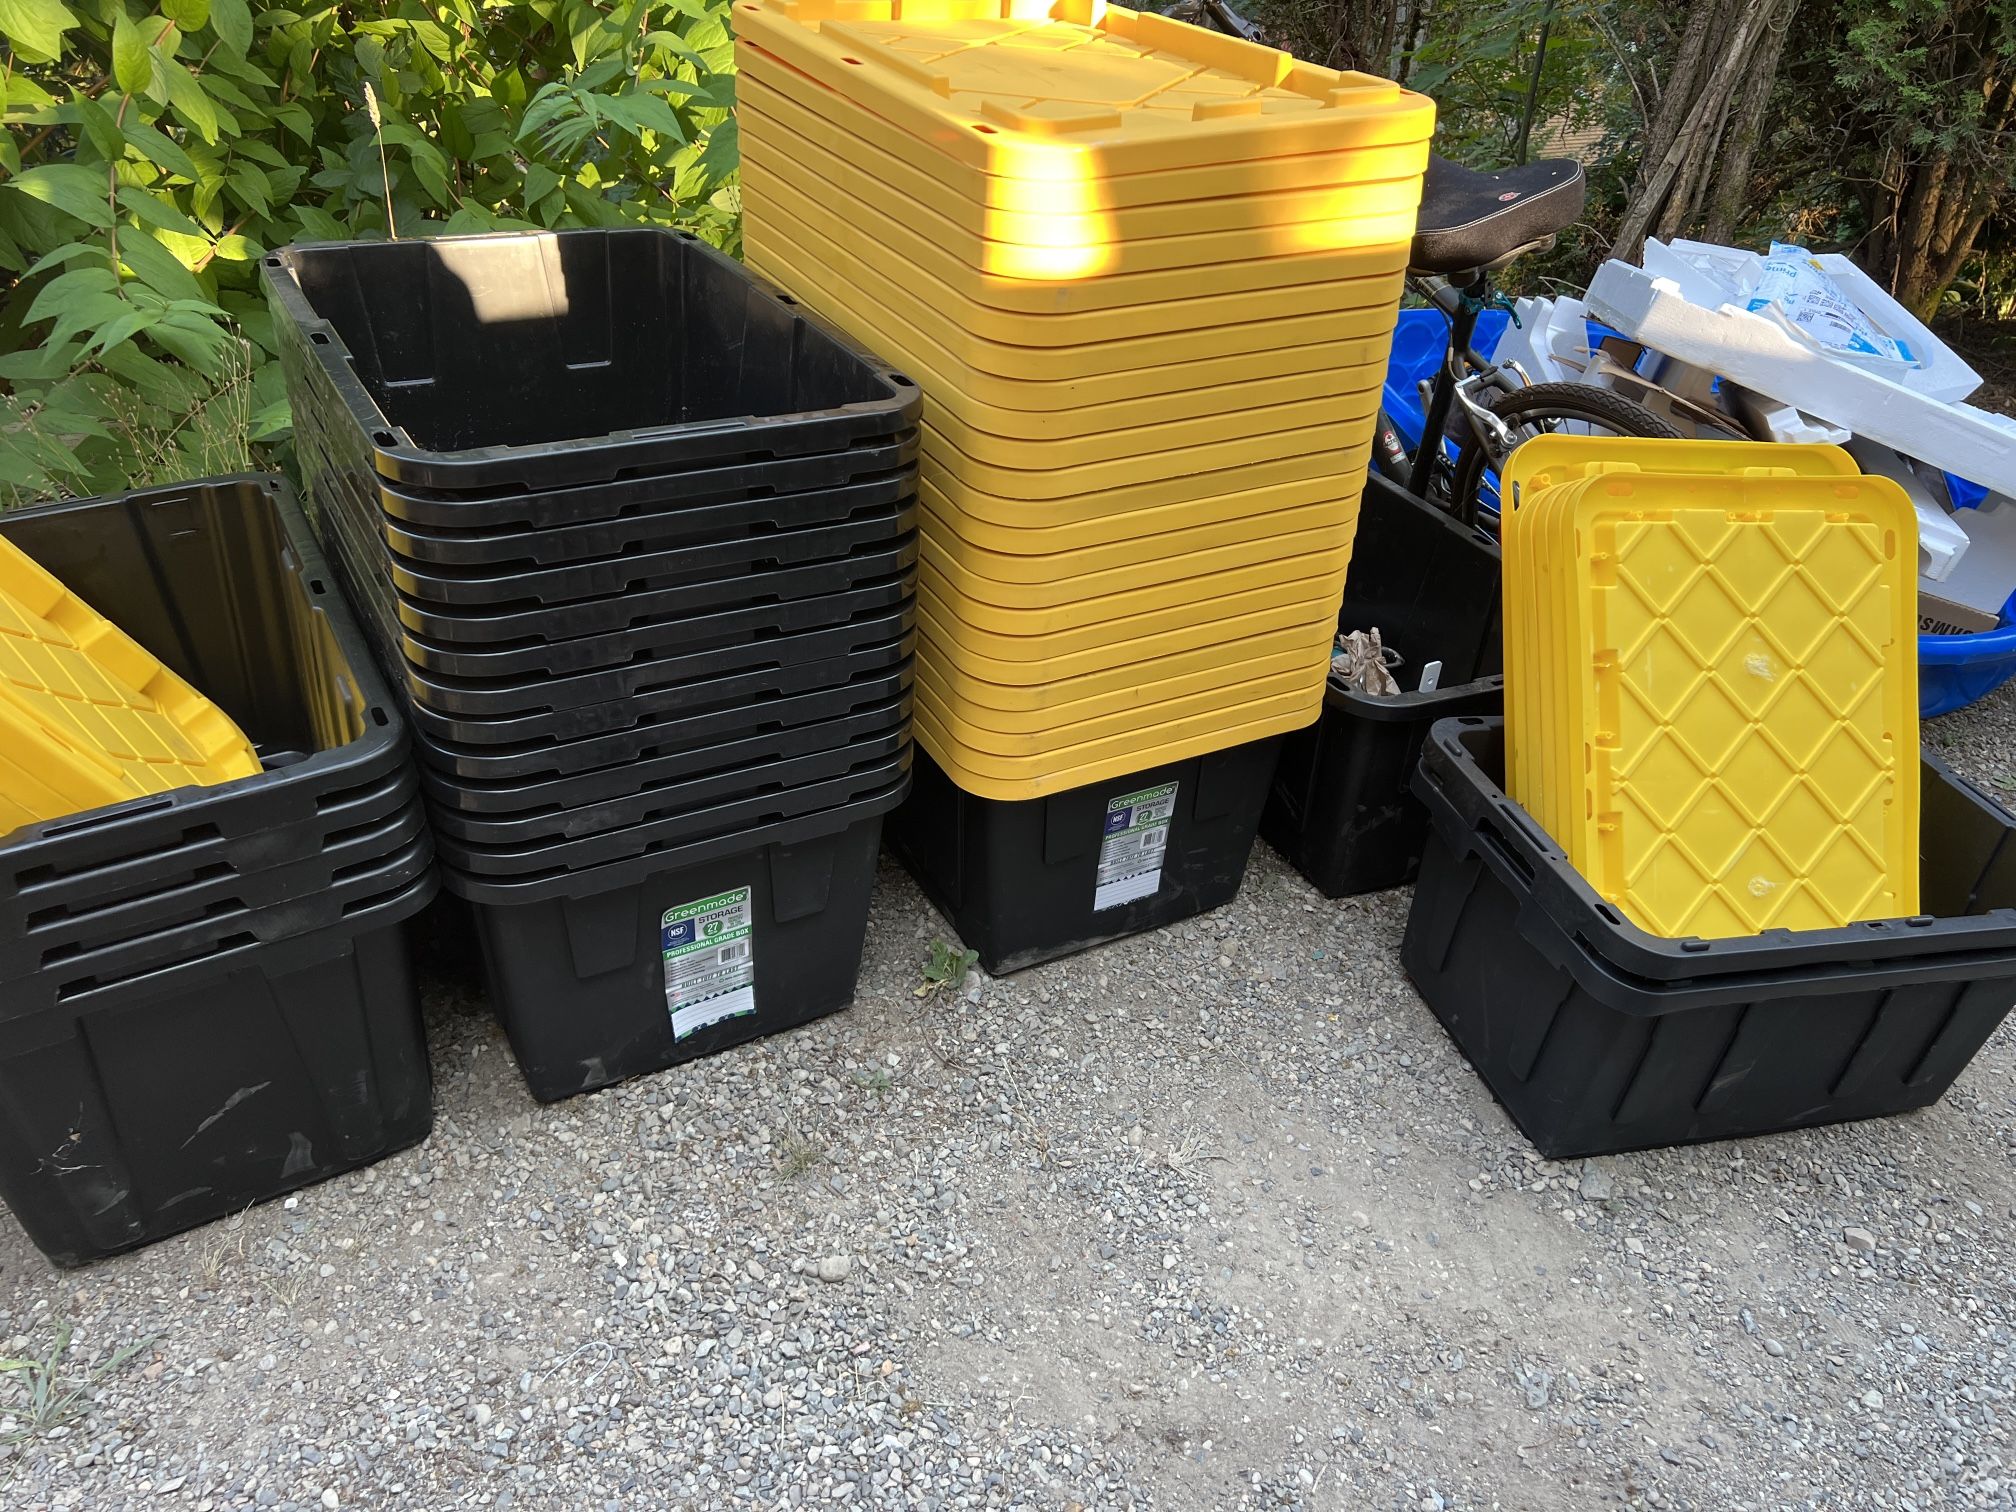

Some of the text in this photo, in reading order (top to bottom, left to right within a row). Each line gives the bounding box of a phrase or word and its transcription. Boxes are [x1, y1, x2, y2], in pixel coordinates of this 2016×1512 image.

[1111, 787, 1173, 809] Greenmade
[1136, 798, 1170, 812] STORAGE
[1112, 813, 1124, 823] NSF
[665, 893, 744, 922] Greenmade
[698, 904, 744, 924] STORAGE
[670, 926, 685, 937] NSF
[707, 921, 719, 932] 27
[666, 938, 713, 958] PROFESSIONAL
[714, 931, 735, 943] GRADE
[736, 927, 749, 937] BOX
